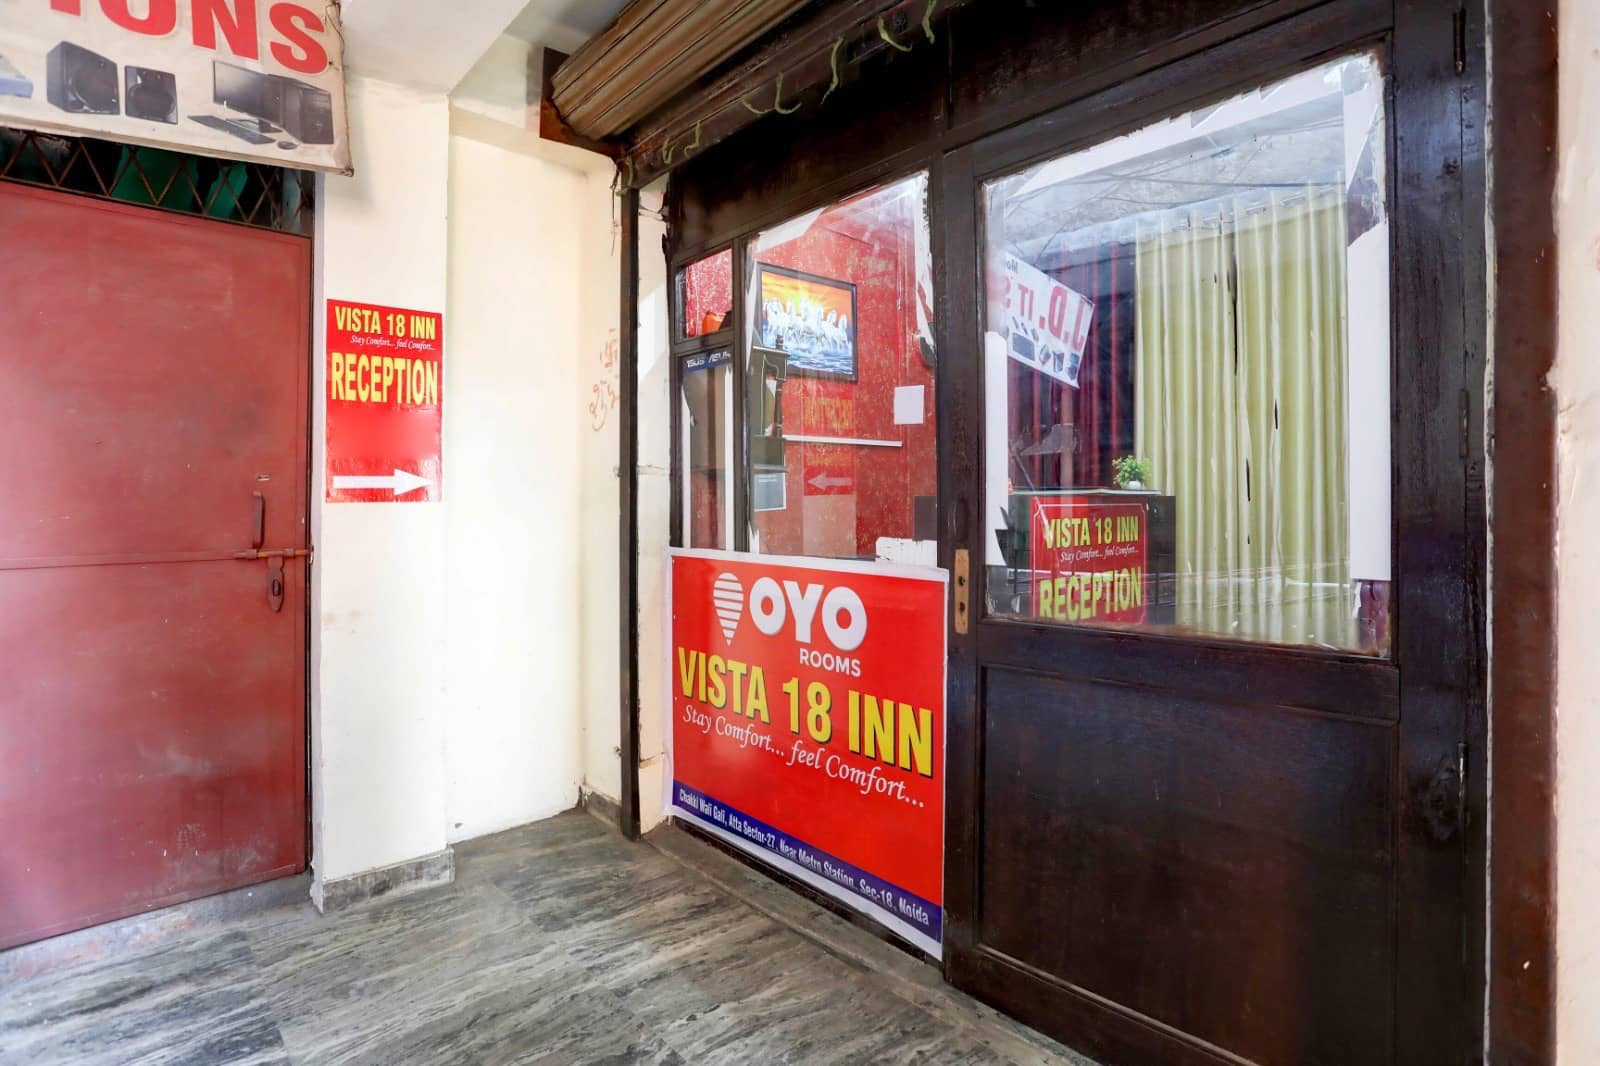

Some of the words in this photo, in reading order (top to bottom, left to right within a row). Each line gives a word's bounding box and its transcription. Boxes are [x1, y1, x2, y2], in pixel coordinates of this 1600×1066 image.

[335, 306, 381, 334] VISTA
[386, 313, 406, 337] 18
[410, 315, 436, 340] INN
[350, 335, 365, 345] Stay
[395, 338, 408, 350] feel
[331, 352, 438, 405] RECEPTION
[1045, 517, 1091, 549] VISTA
[1095, 517, 1113, 545] 18
[1117, 515, 1139, 542] INN
[1060, 550, 1075, 562] Stay
[749, 576, 868, 651] OYO
[1039, 567, 1142, 621] RECEPTION
[799, 647, 862, 678] ROOMS
[678, 646, 771, 724] VISTA
[782, 676, 833, 744] 18
[848, 689, 933, 779] INN
[682, 704, 712, 734] Stay
[715, 716, 785, 756] Comfort...
[786, 740, 824, 769] feel
[825, 755, 925, 808] Comfort...
[679, 788, 699, 809] Chakki
[699, 797, 712, 817] Wali
[728, 814, 742, 832] Atta
[780, 839, 797, 858] Near
[798, 849, 822, 870] Metro
[899, 896, 930, 926] Noida
